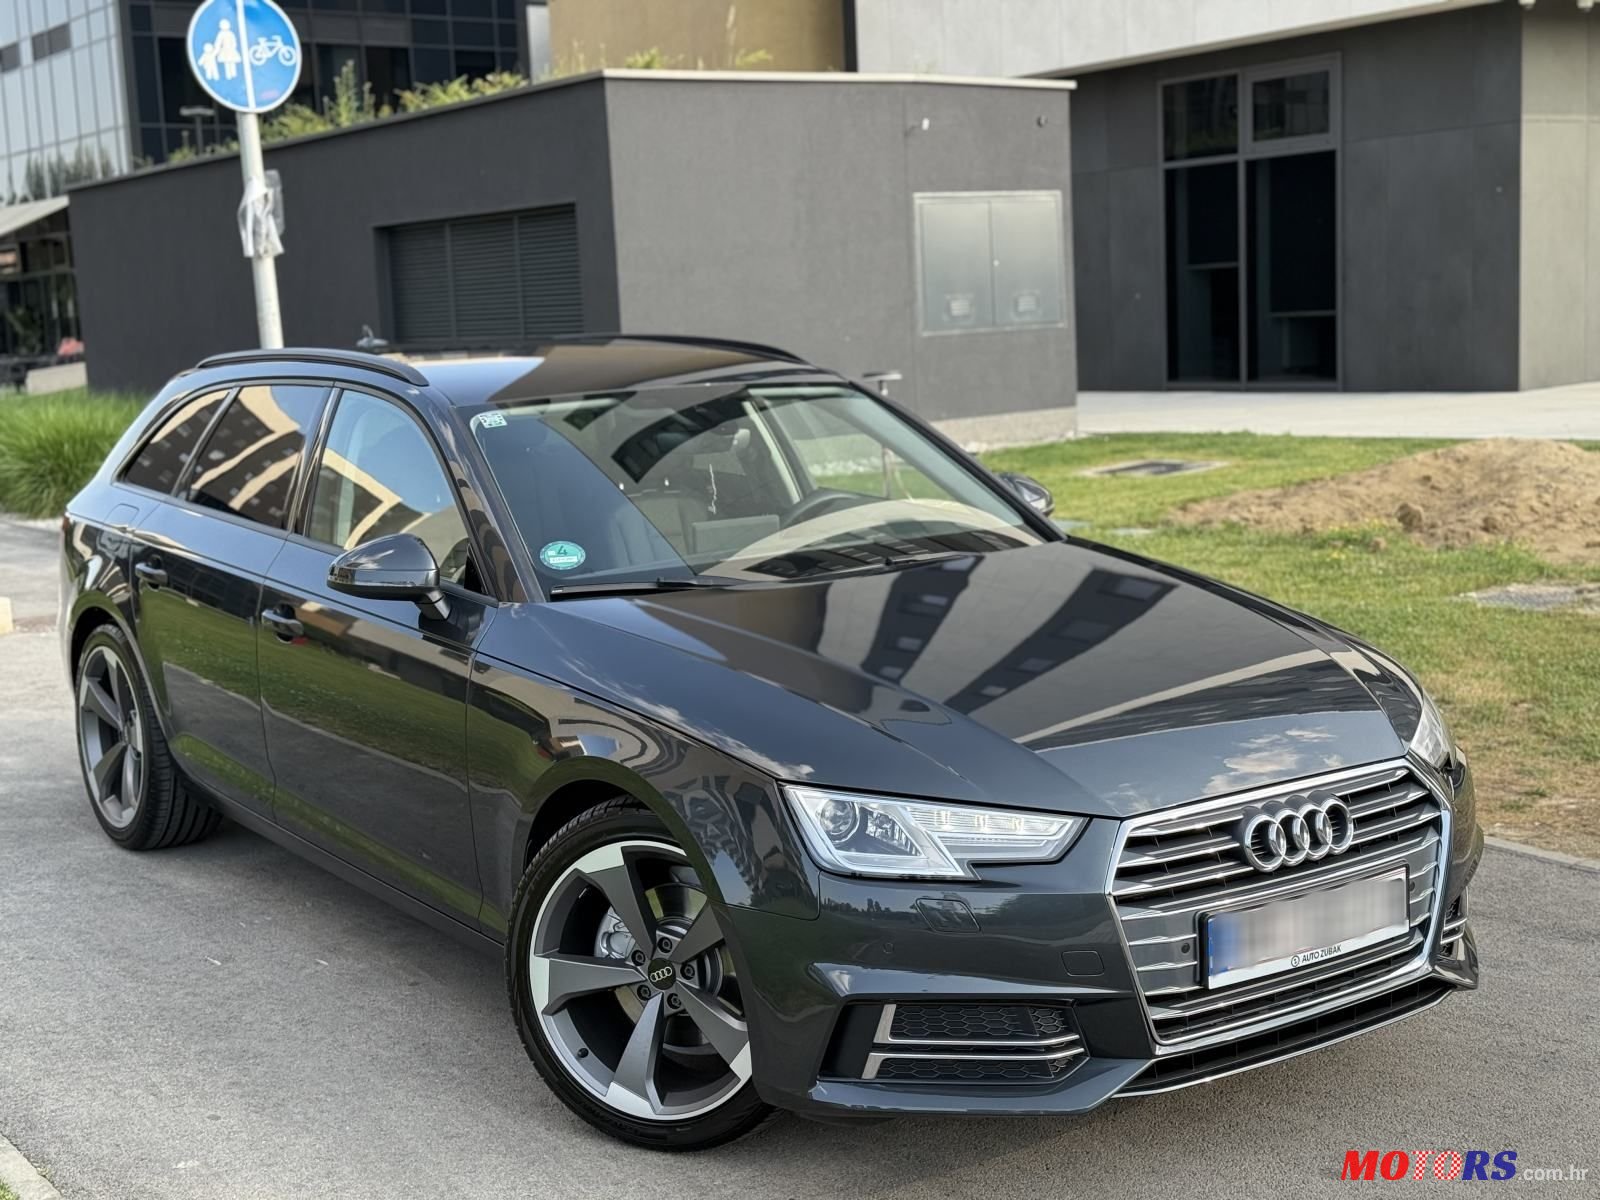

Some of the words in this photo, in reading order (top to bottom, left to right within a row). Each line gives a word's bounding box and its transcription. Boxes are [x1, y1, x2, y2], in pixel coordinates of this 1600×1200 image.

[557, 545, 568, 556] 4
[1302, 951, 1320, 963] AUTO
[1320, 945, 1342, 958] ZUBAK
